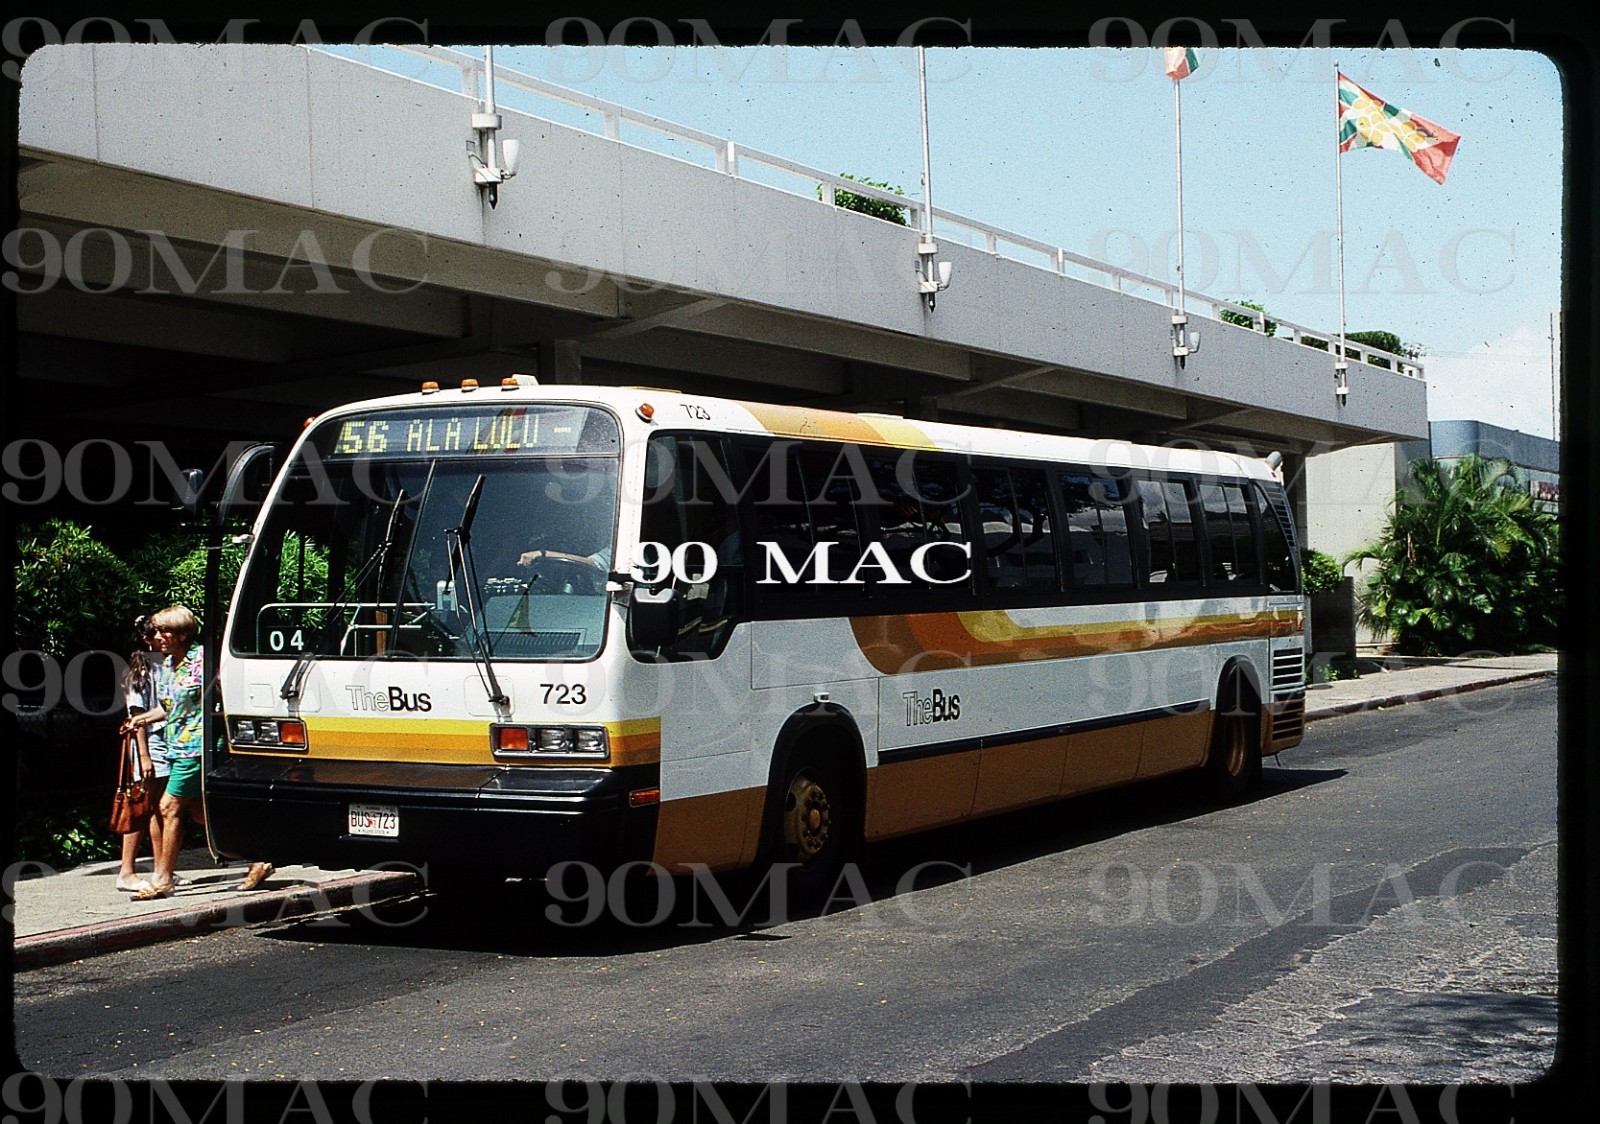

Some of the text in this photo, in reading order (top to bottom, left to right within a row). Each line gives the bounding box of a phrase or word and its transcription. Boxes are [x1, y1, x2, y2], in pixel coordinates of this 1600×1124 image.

[680, 404, 711, 421] 723
[341, 420, 389, 454] 56
[406, 418, 461, 452] ALA
[345, 684, 432, 712] TheBus
[540, 683, 587, 705] 723
[902, 688, 961, 727] TheBus
[350, 810, 396, 829] BUS 723
